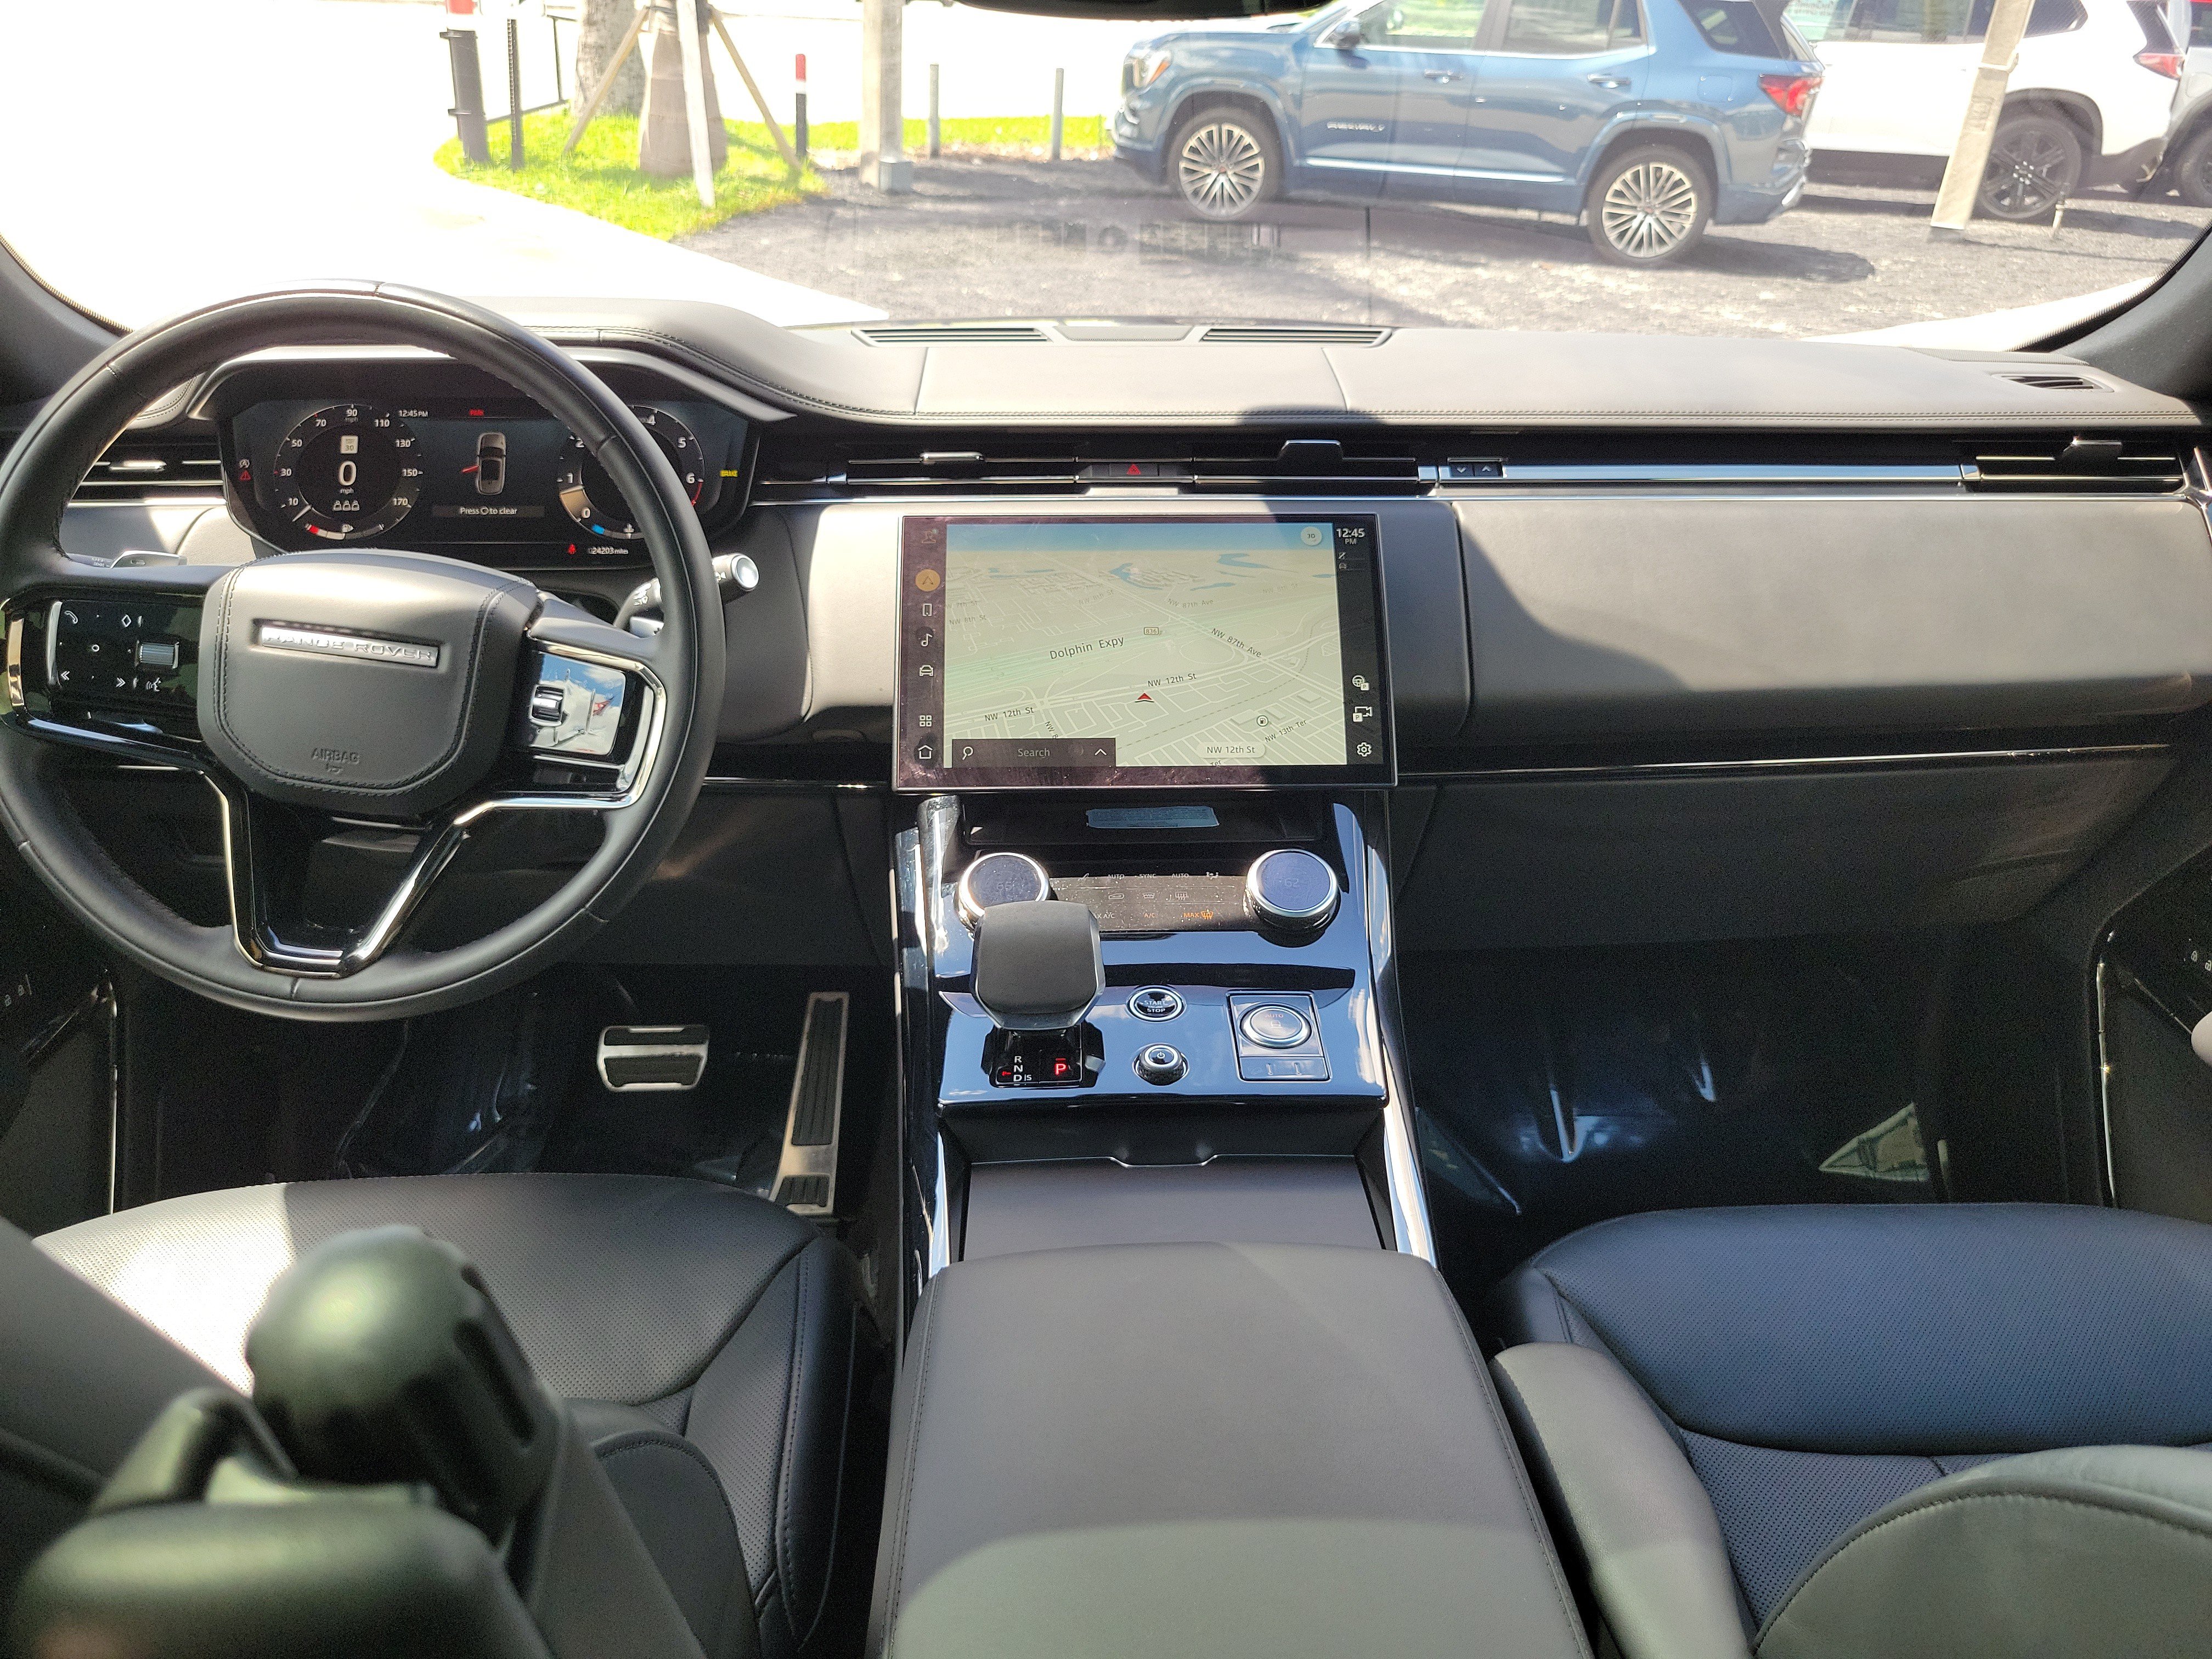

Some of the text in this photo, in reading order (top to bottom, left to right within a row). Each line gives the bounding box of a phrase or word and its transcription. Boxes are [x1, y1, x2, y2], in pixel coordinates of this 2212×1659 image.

[346, 409, 358, 417] 90
[374, 419, 390, 427] 110
[648, 415, 656, 425] 4
[291, 439, 302, 447] 50
[395, 439, 411, 448] 130
[575, 437, 585, 448] 2
[678, 437, 686, 448] 5
[338, 460, 357, 486] 0
[403, 469, 419, 477] 150
[565, 473, 573, 483] 1
[686, 473, 695, 483] 6
[392, 498, 409, 506] 170
[581, 507, 591, 518] 0
[1336, 527, 1365, 538] 12:45
[1167, 599, 1179, 607] NW
[1049, 636, 1125, 660] Dolphin Expy
[1211, 628, 1262, 658] NW 87th Ave
[353, 642, 433, 661] ROVER
[1148, 679, 1161, 687] NW
[1166, 675, 1184, 685] 12th
[984, 706, 1035, 722] NW 12th St
[1045, 721, 1056, 732] NW
[1265, 719, 1307, 743] NW 13th Ter
[311, 748, 361, 765] AIRBAG
[1018, 747, 1050, 758] Search
[1014, 1056, 1023, 1064] R
[1013, 1064, 1023, 1073] N
[1054, 1063, 1067, 1076] P
